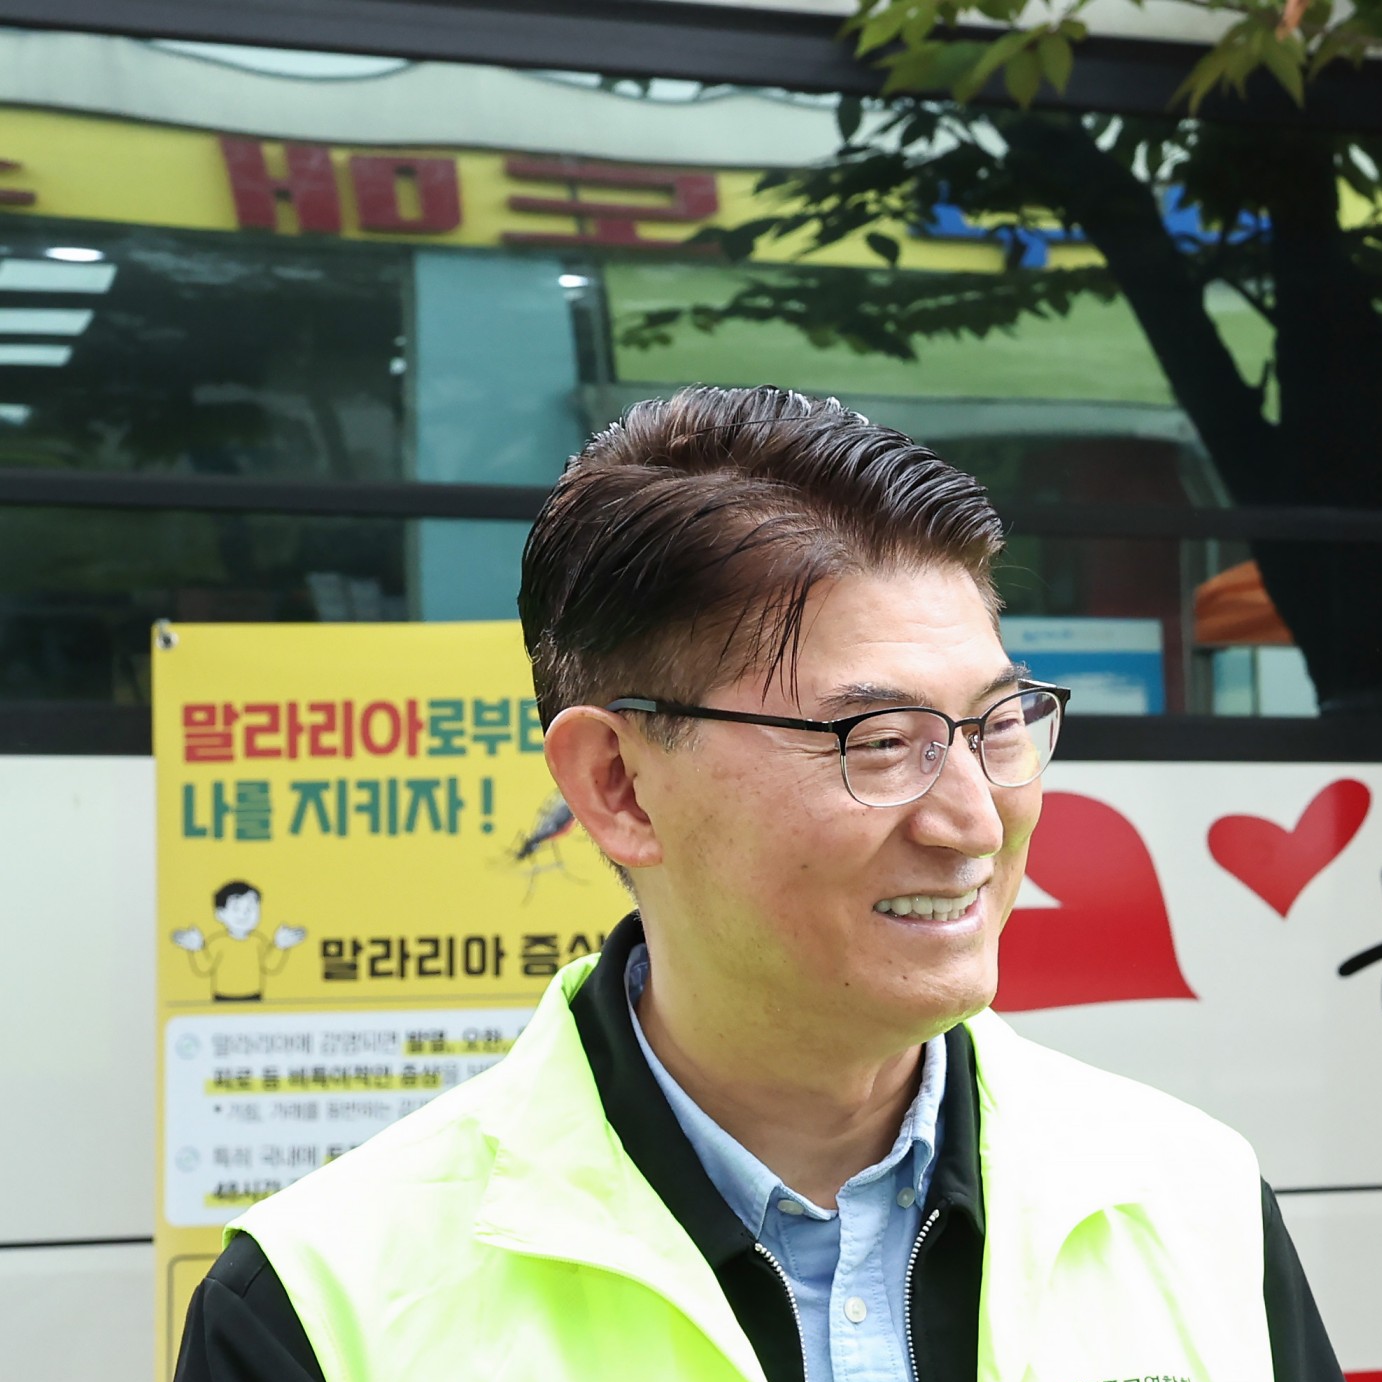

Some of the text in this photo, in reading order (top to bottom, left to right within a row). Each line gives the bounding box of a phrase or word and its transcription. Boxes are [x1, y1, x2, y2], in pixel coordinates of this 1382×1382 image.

[182, 780, 272, 841] 나를
[289, 777, 465, 838] 지키자
[321, 937, 506, 981] 말라리아
